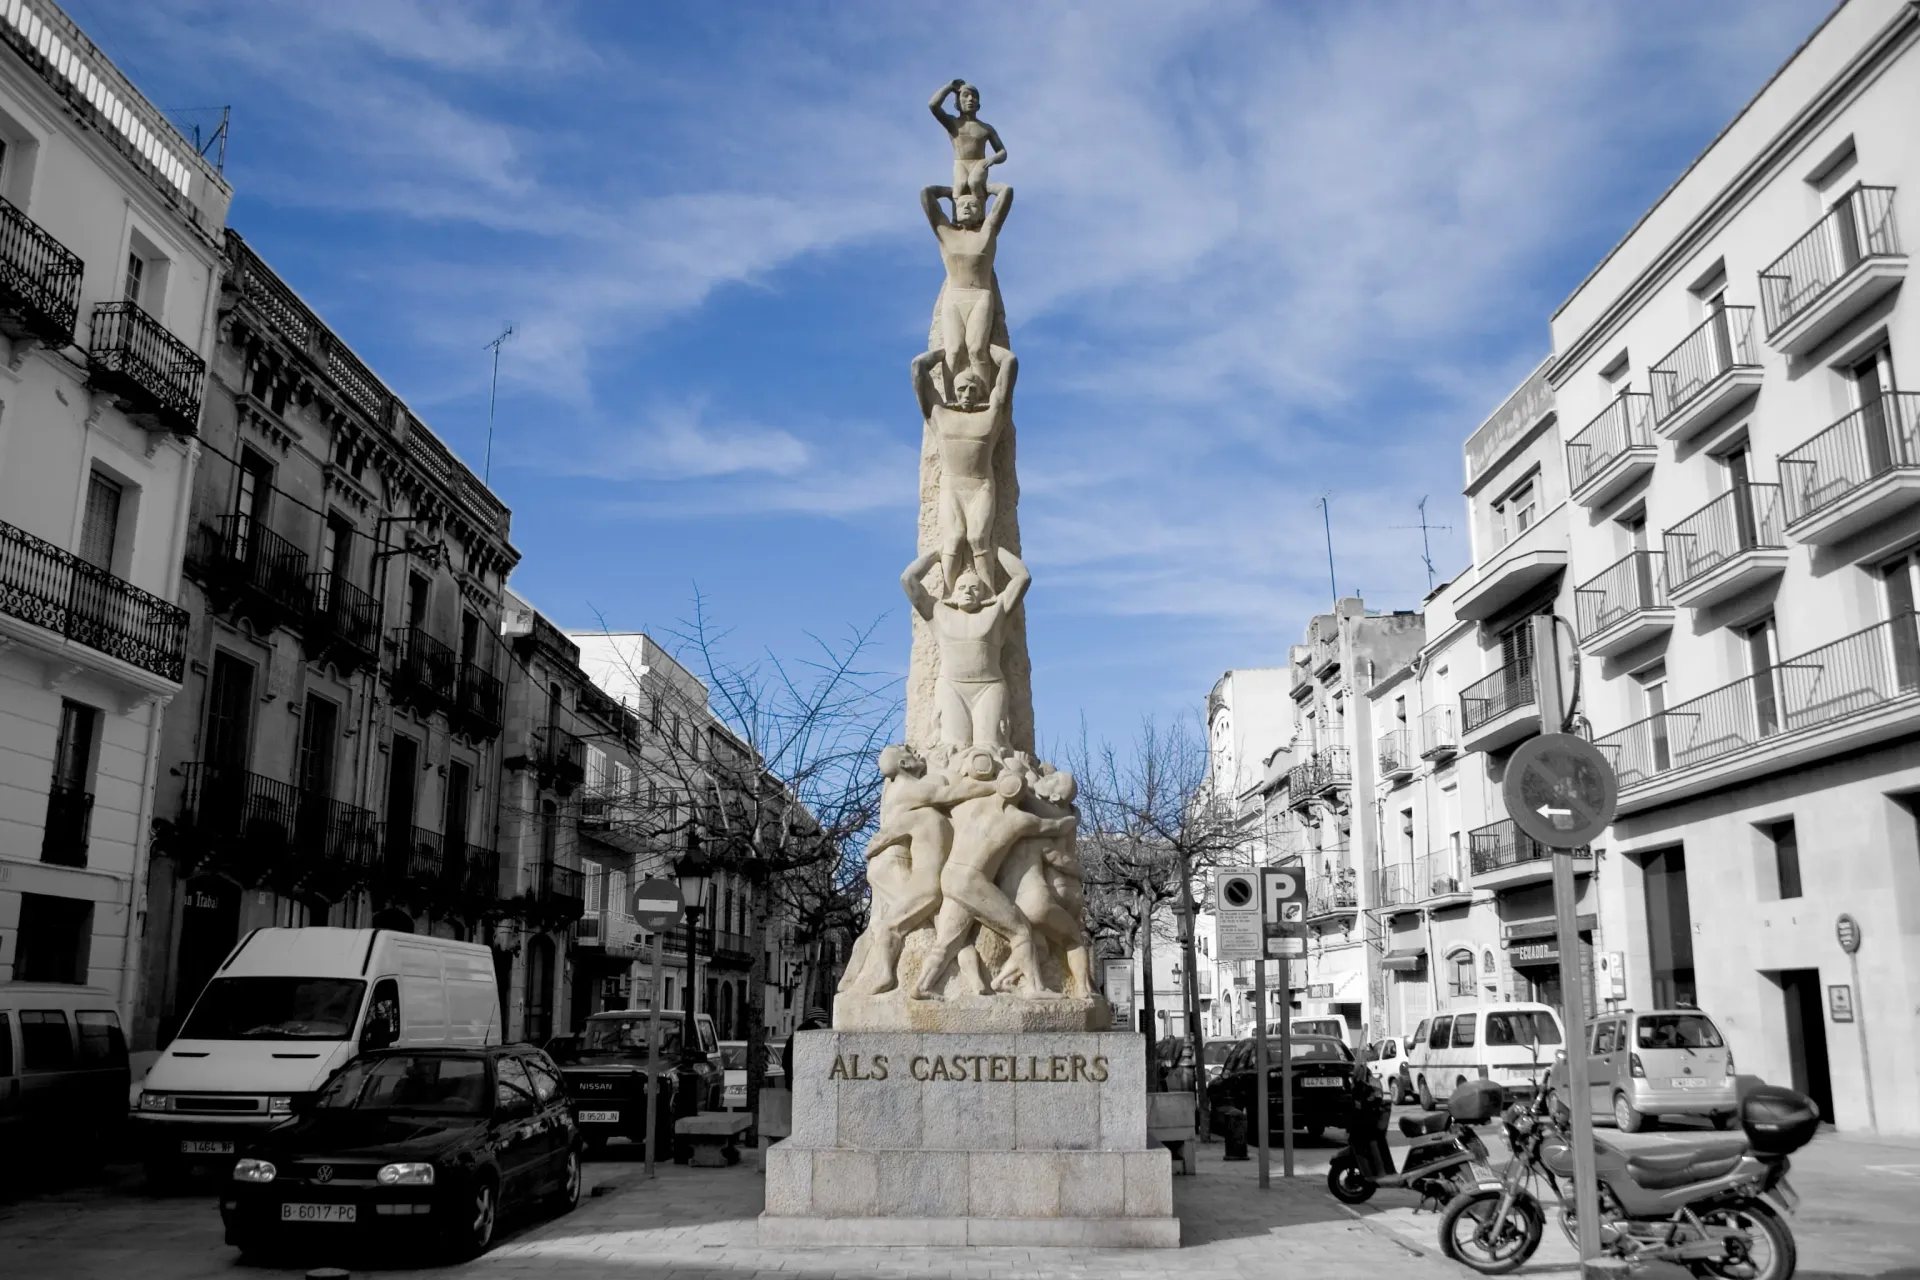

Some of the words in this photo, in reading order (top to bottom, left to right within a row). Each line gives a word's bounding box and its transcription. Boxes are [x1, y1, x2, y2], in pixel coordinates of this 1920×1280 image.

[1265, 873, 1296, 923] P
[1520, 944, 1549, 960] ECUADOR
[829, 1054, 889, 1081] ALS
[910, 1054, 1109, 1083] CASTELLERS
